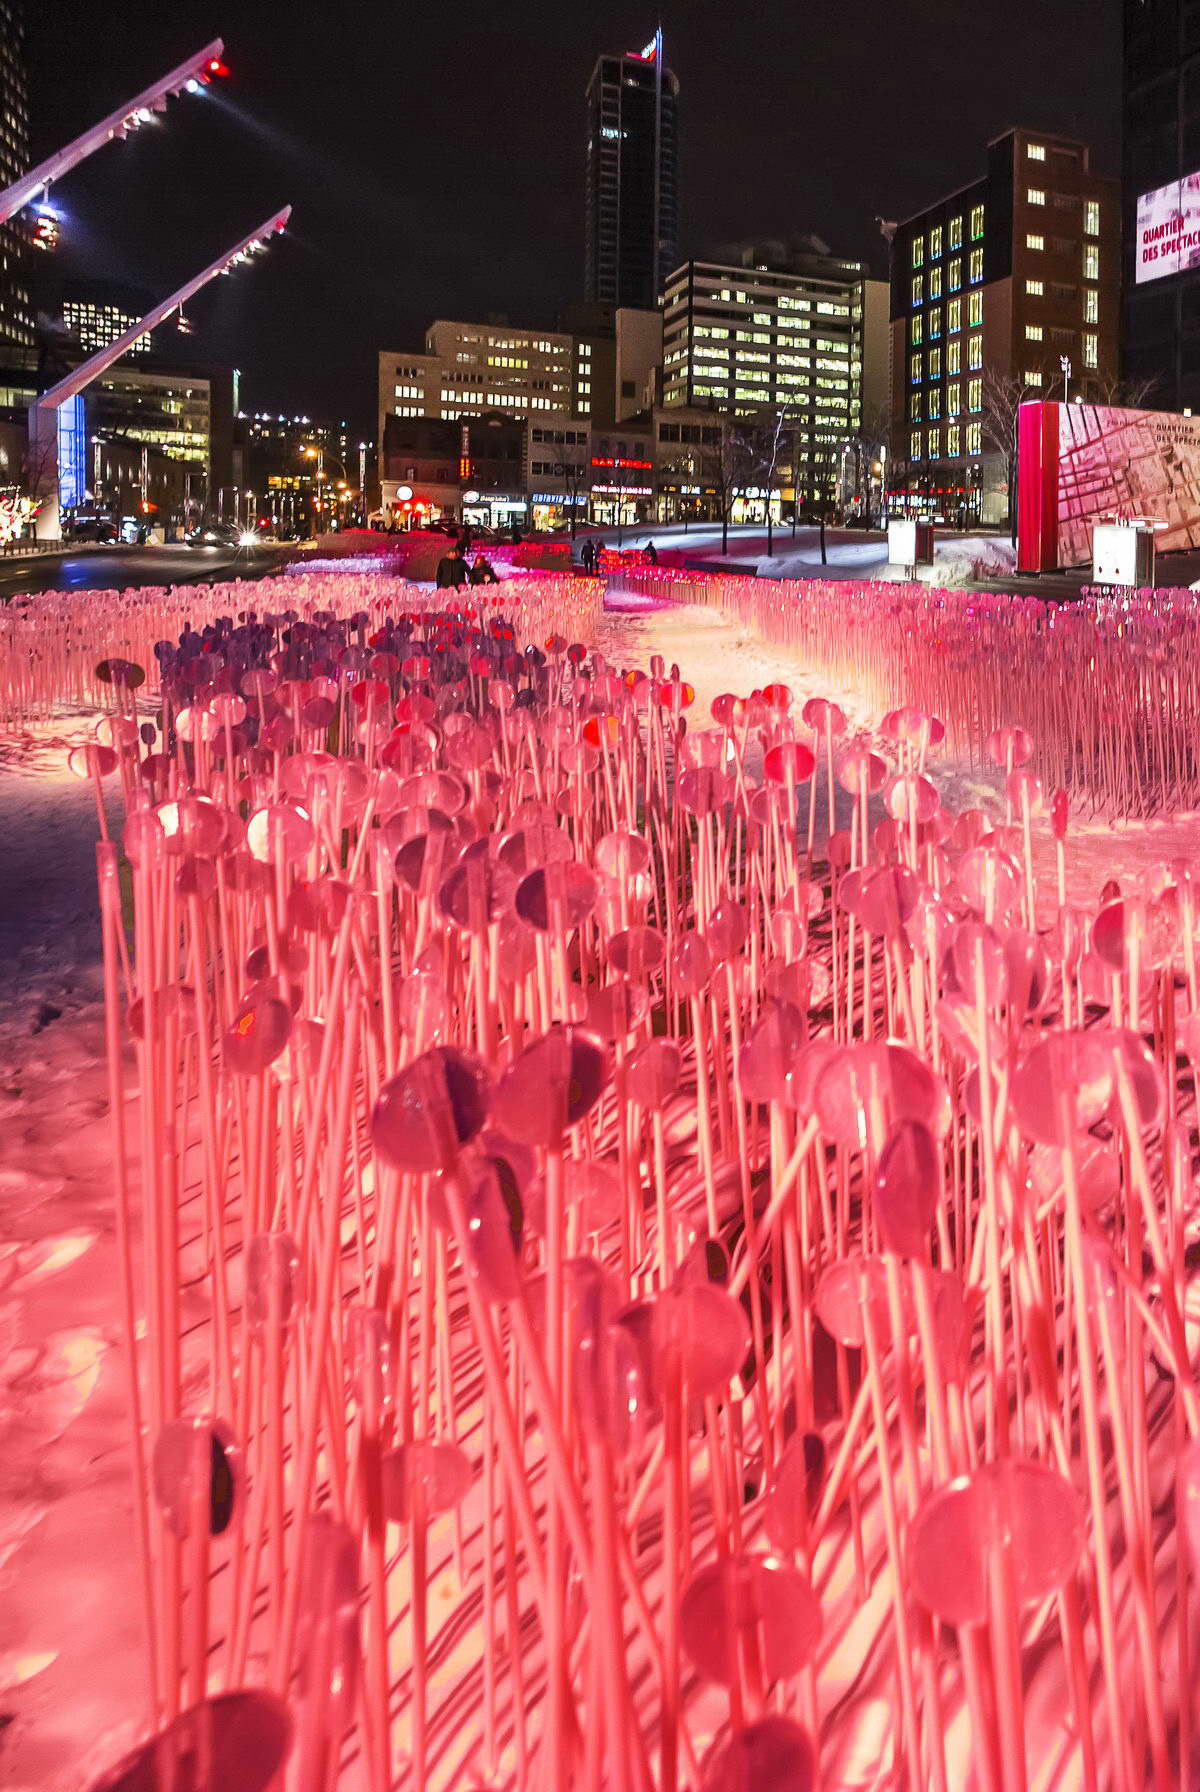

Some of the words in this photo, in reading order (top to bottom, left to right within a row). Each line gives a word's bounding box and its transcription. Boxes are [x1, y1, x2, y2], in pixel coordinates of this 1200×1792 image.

[1143, 215, 1185, 244] QUARTIER
[1143, 245, 1158, 263] DES
[1156, 424, 1194, 433] QUARTIER
[1156, 435, 1171, 443] DES
